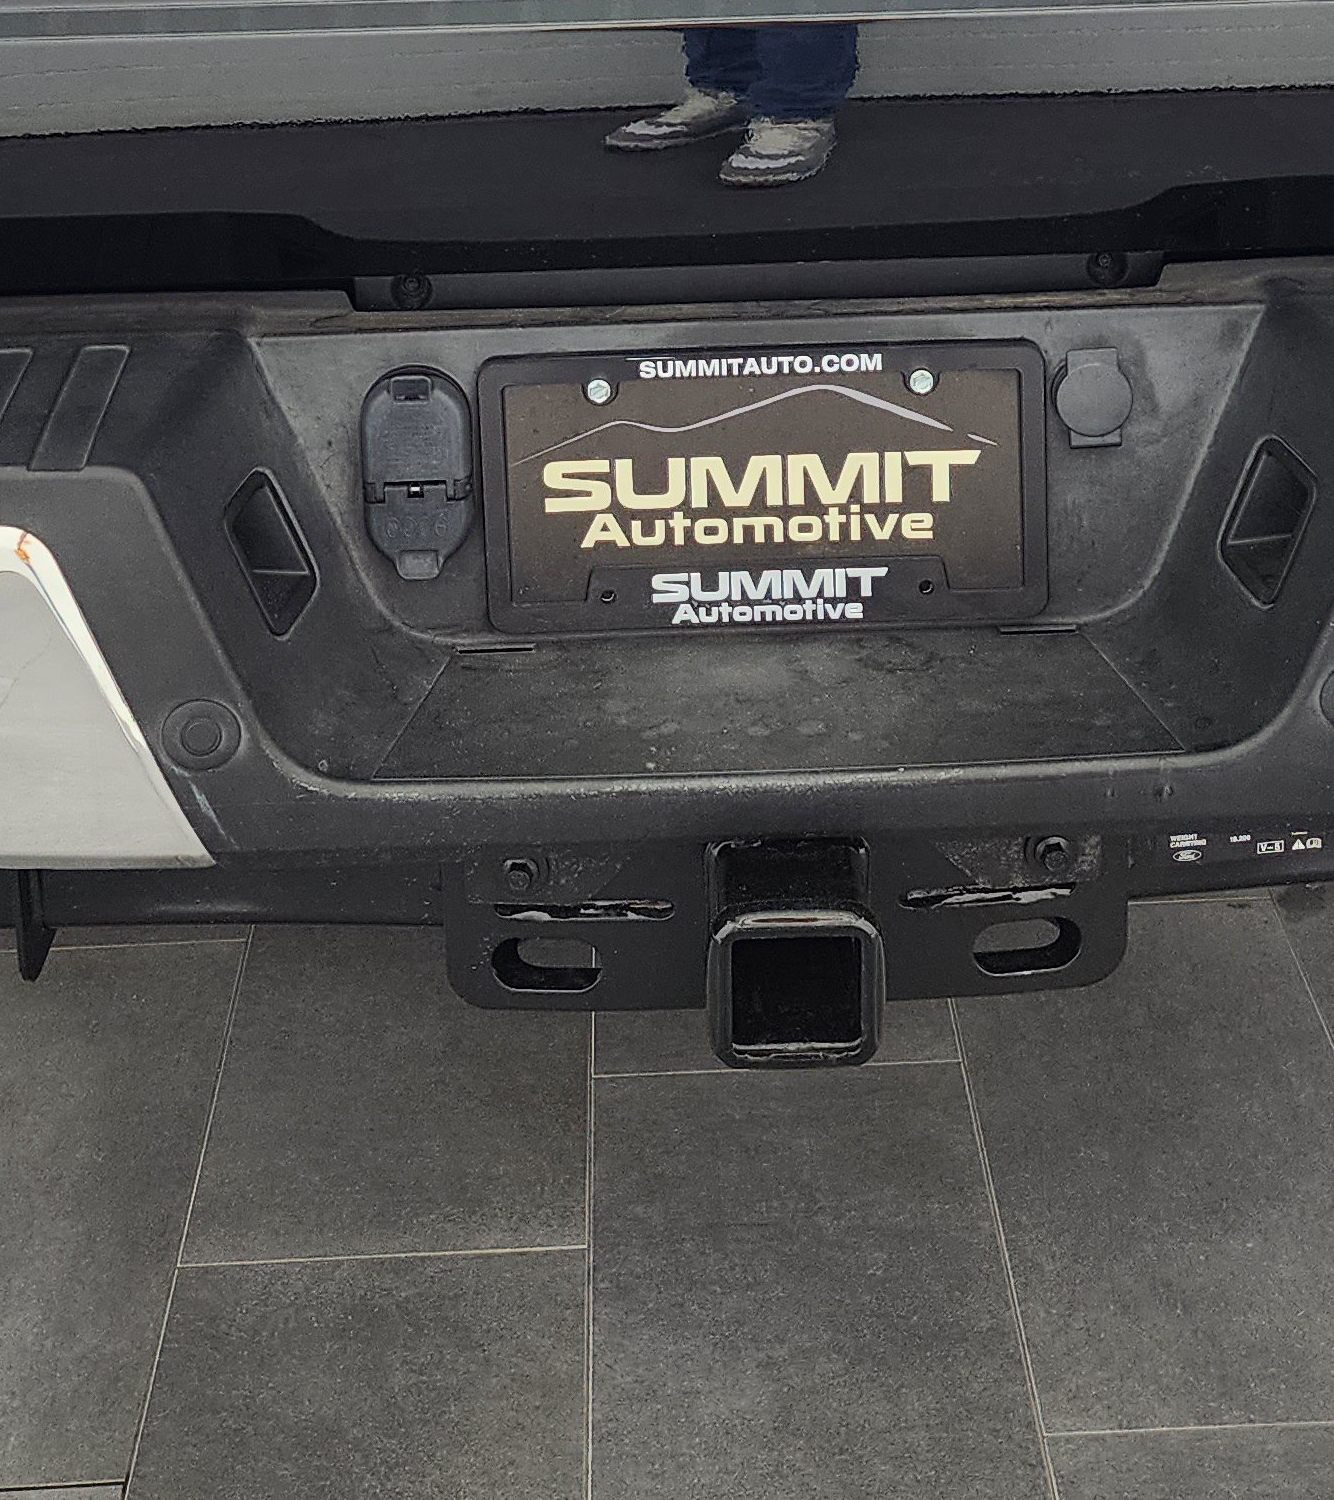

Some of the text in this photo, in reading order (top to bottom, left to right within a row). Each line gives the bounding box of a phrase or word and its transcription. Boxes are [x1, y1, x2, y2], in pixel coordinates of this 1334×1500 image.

[639, 354, 883, 379] SUMMITAUTO.COM
[543, 449, 982, 513] SUMMIT
[580, 504, 934, 548] Automotive
[651, 567, 889, 603] SUMMIT
[672, 599, 864, 624] Automotive
